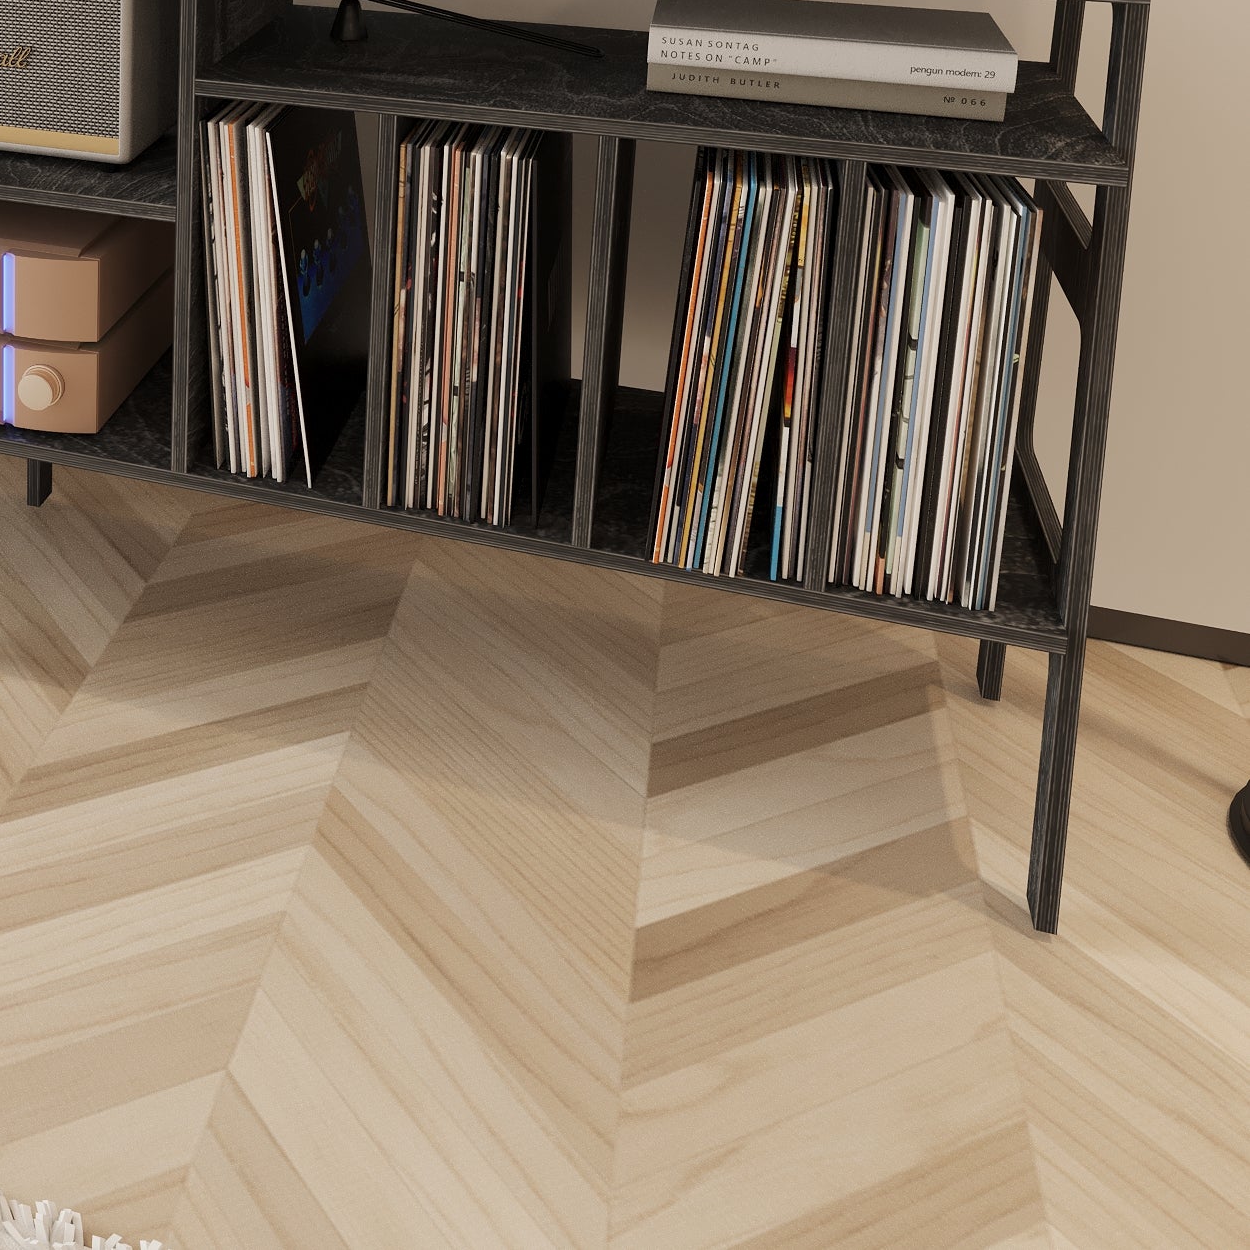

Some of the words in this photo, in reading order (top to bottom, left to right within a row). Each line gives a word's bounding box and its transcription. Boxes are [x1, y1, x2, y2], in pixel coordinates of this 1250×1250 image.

[661, 36, 703, 47] SUSAN
[707, 40, 759, 52] SONTAG
[660, 50, 701, 61] NOTES
[705, 53, 723, 63] ON
[671, 73, 720, 84] JUDITH
[729, 77, 780, 89] BUTLER
[984, 70, 996, 79] 29
